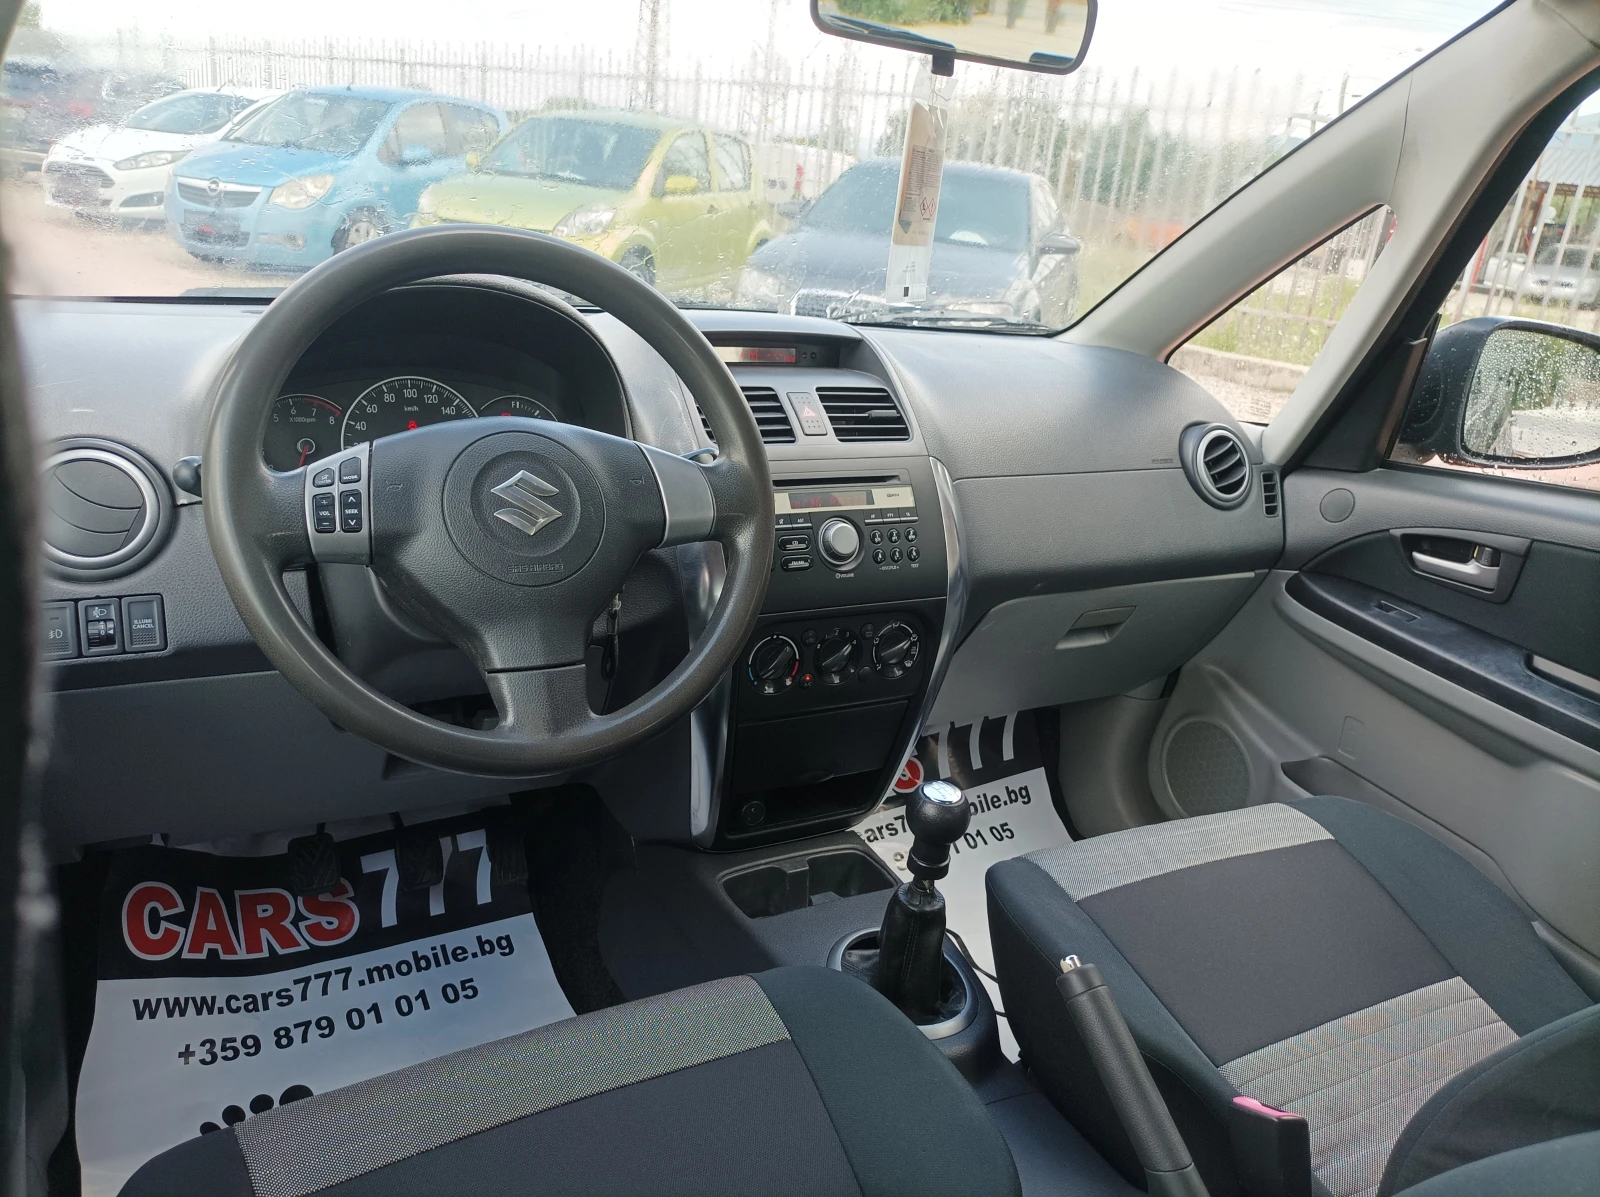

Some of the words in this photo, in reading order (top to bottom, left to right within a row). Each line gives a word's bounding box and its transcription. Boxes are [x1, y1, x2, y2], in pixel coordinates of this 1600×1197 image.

[403, 389, 418, 398] 100
[384, 394, 395, 403] 80
[424, 395, 438, 403] 120
[312, 408, 316, 416] 7
[367, 405, 378, 413] 60
[441, 406, 456, 415] 140
[273, 414, 279, 422] 5
[329, 416, 335, 424] 8
[355, 422, 367, 431] 40
[963, 829, 988, 849] 01
[989, 822, 1015, 842] 05
[133, 932, 514, 1020] www.cars777.mobile.bg
[178, 1034, 262, 1066] +359
[273, 1015, 336, 1050] 879
[345, 1002, 384, 1030] 01
[395, 989, 431, 1017] 01
[441, 977, 479, 1005] 05
